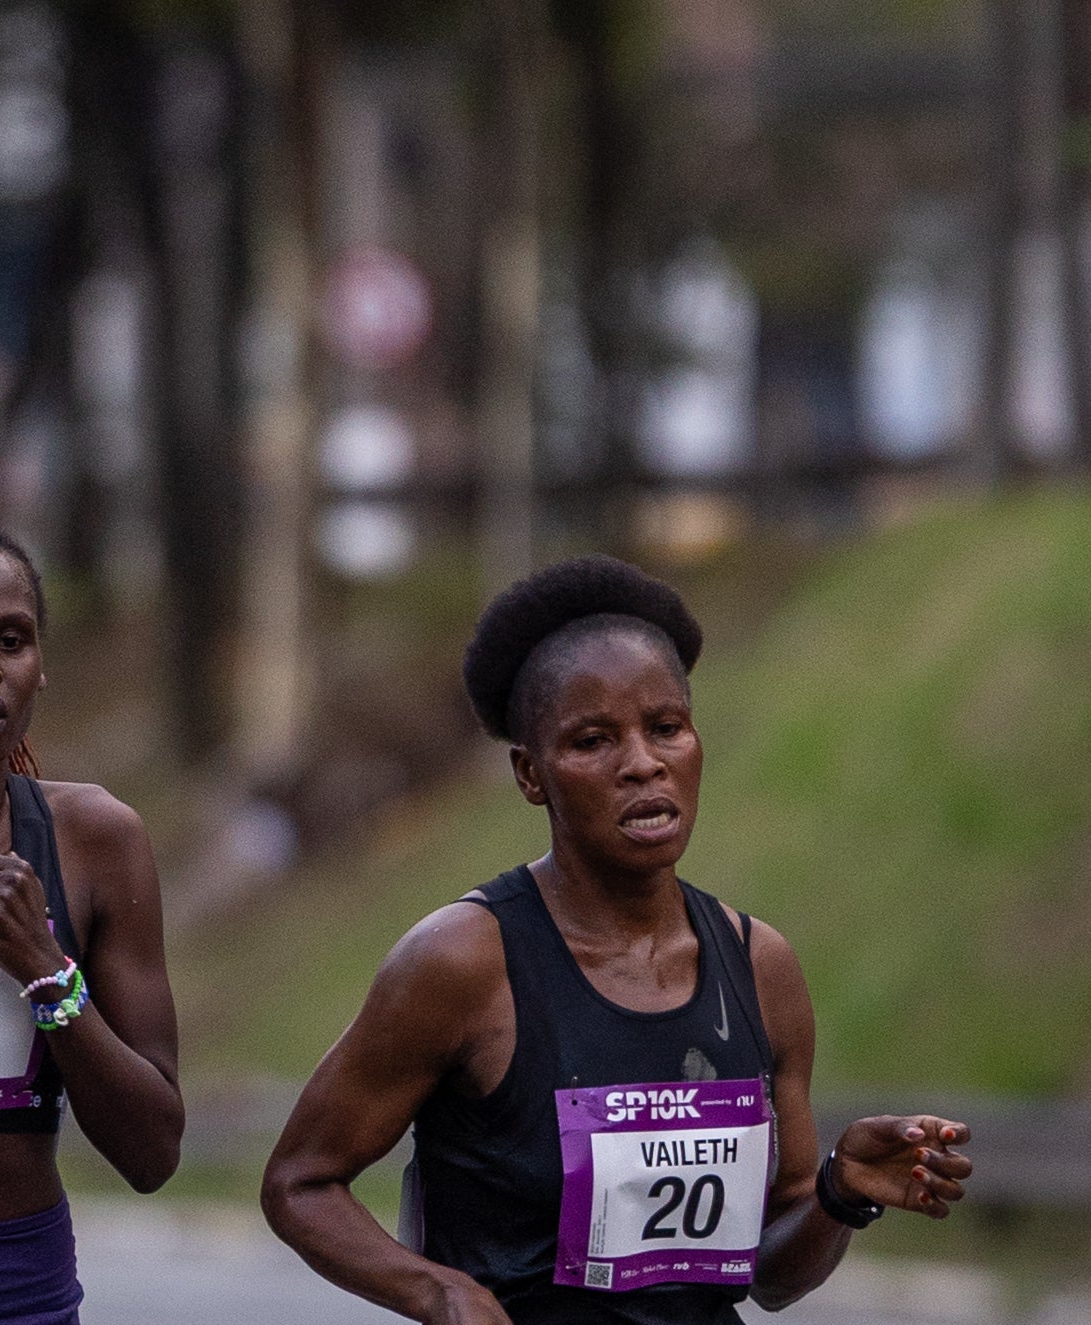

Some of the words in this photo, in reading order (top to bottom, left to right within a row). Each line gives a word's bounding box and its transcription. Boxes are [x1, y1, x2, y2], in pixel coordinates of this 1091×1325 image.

[605, 1088, 702, 1122] SP10K
[641, 1138, 738, 1168] VAILETH
[641, 1174, 725, 1242] 20
